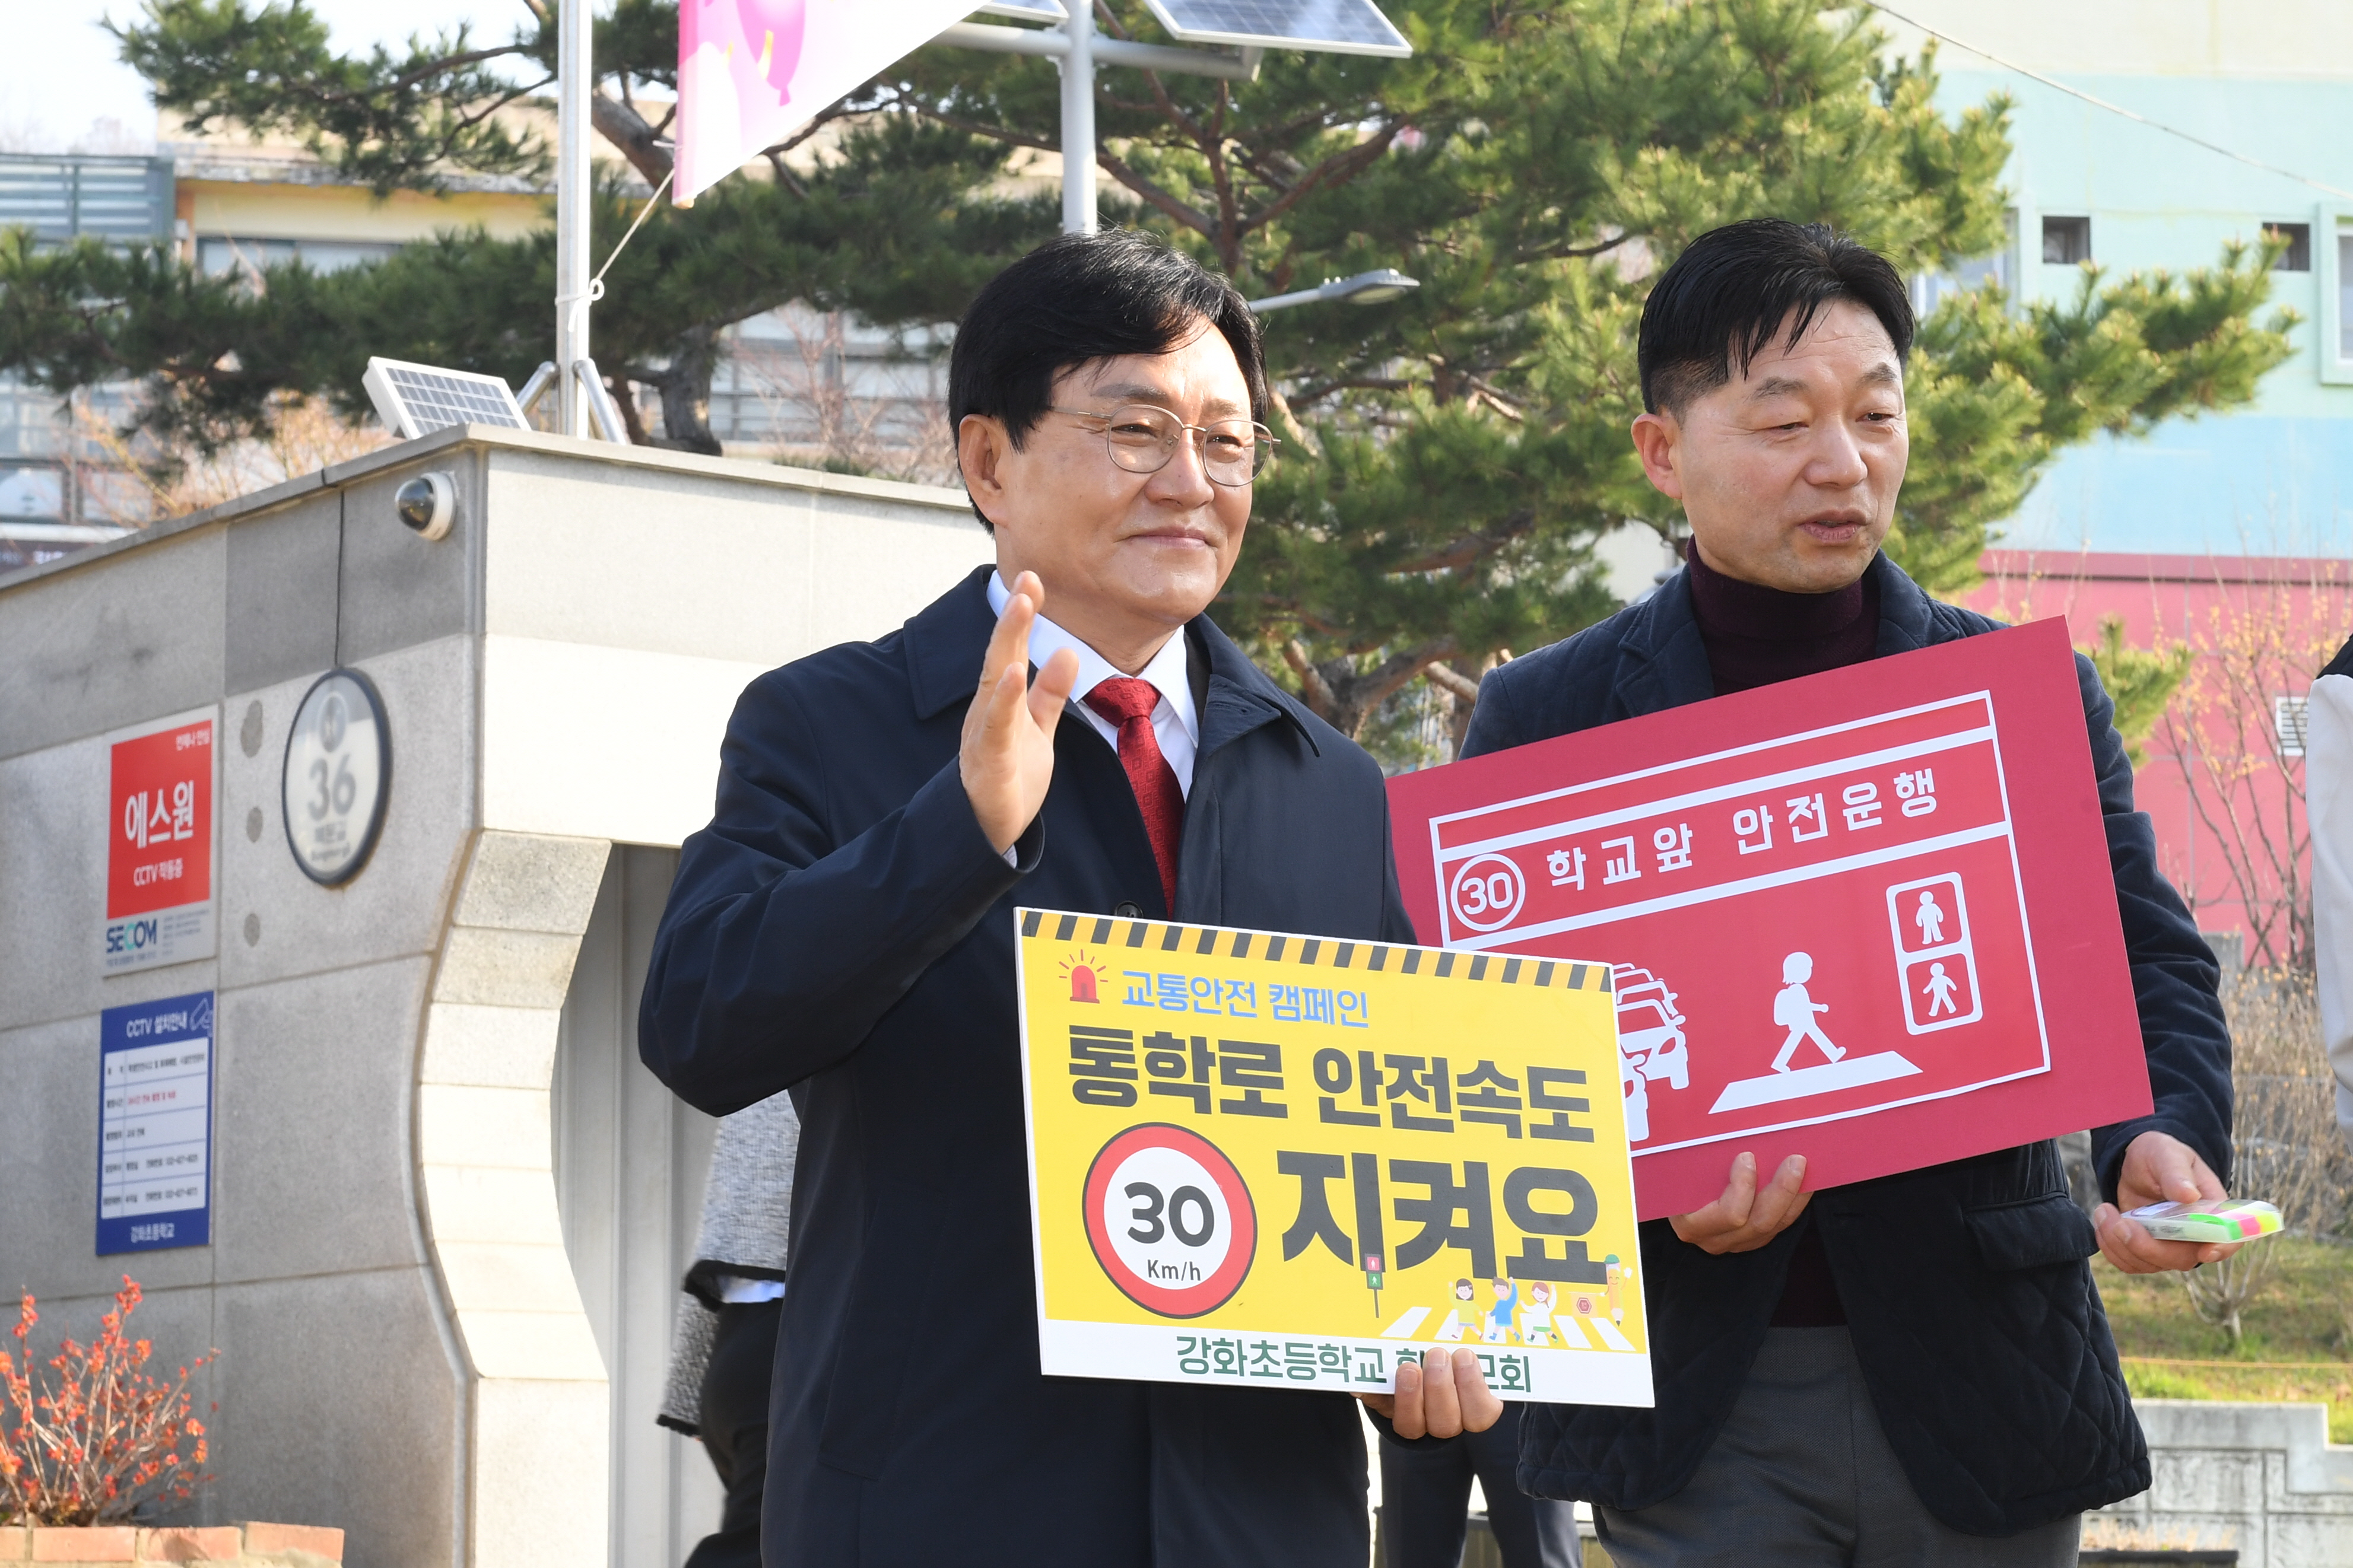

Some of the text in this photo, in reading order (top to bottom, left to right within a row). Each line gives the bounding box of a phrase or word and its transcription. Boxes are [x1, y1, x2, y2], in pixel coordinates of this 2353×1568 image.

[124, 780, 195, 849] 에스원
[308, 753, 357, 821] 36
[1547, 768, 1938, 890] 학교앞 안전운행
[134, 863, 158, 886] CCTV
[1460, 872, 1514, 915] 30
[106, 919, 157, 953] SECOM
[126, 1017, 153, 1038] CCTV
[1122, 970, 1369, 1028] 교통안전 캠페인
[1069, 1025, 1595, 1143] 통학로 안전속도
[1124, 1182, 1214, 1247] 30
[1276, 1151, 1608, 1285] 지켜요
[1147, 1259, 1201, 1281] Km/h
[1176, 1335, 1387, 1383] 강화초등학교
